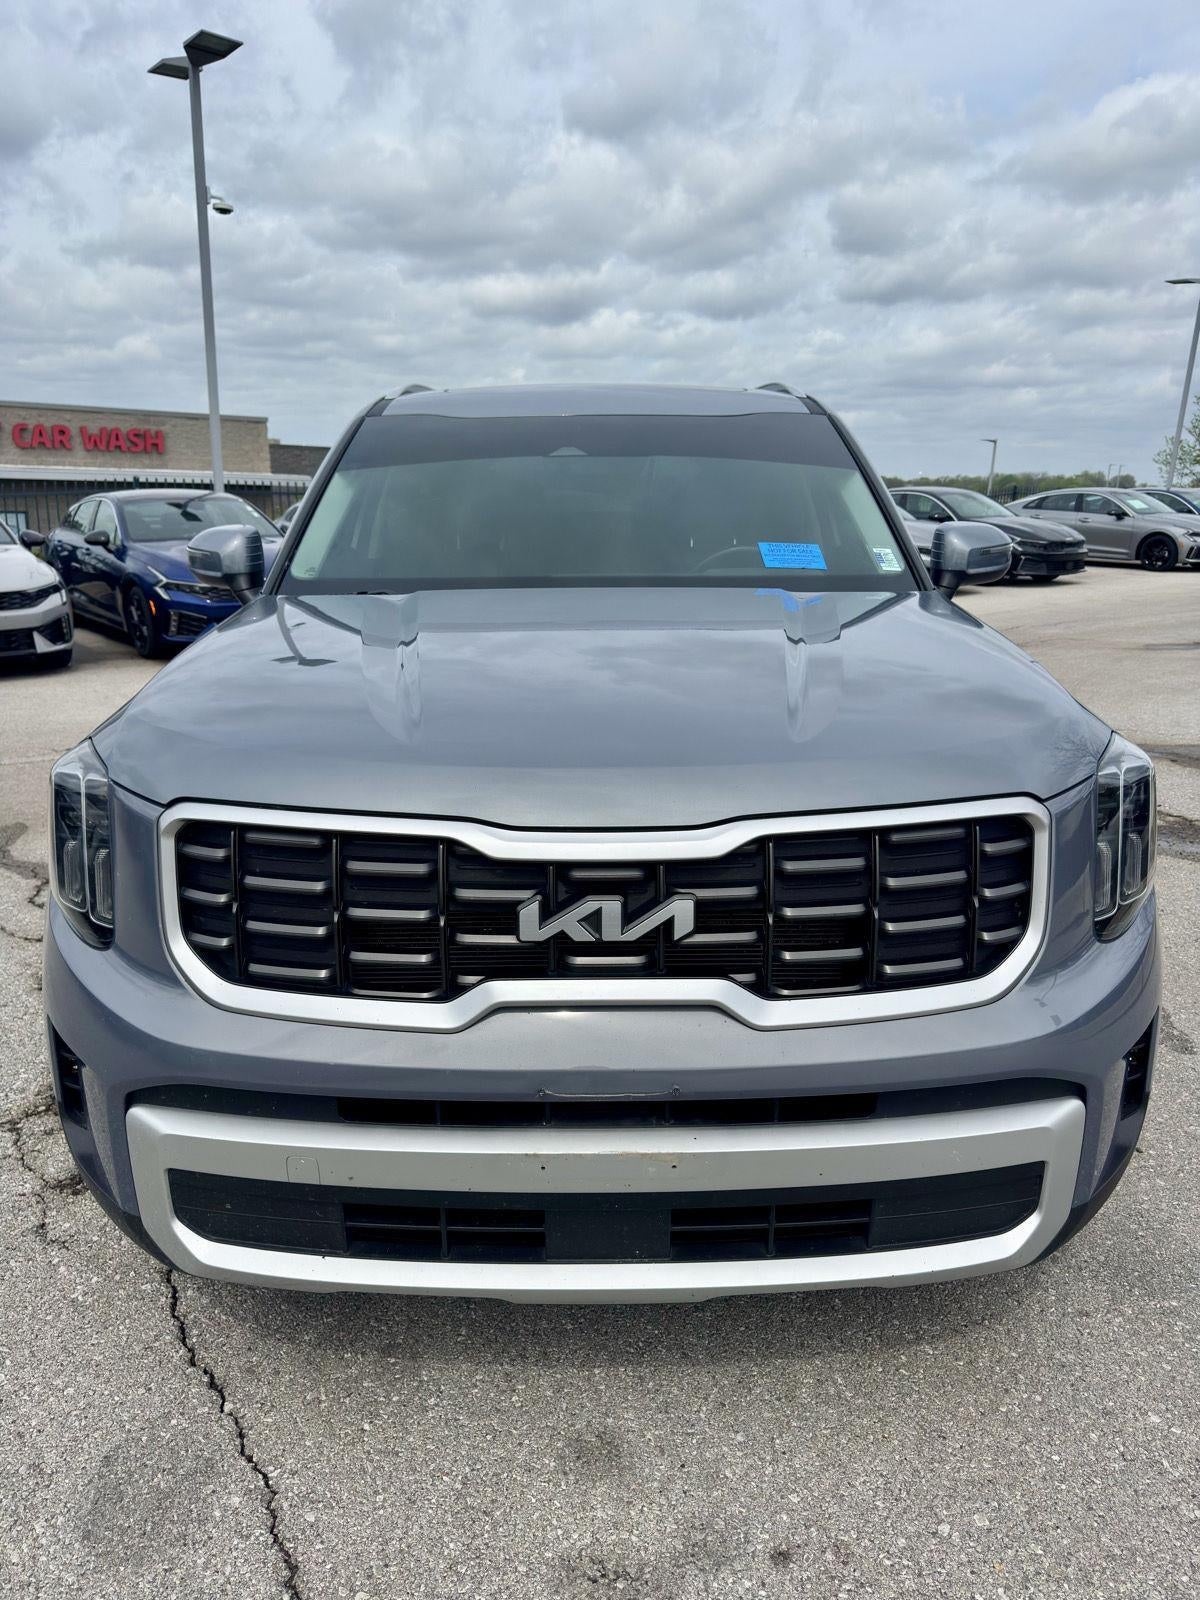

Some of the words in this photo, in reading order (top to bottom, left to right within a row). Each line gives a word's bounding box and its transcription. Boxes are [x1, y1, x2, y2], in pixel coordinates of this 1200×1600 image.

[12, 423, 72, 449] CAR
[80, 425, 165, 454] WASH
[517, 893, 697, 942] KIA
